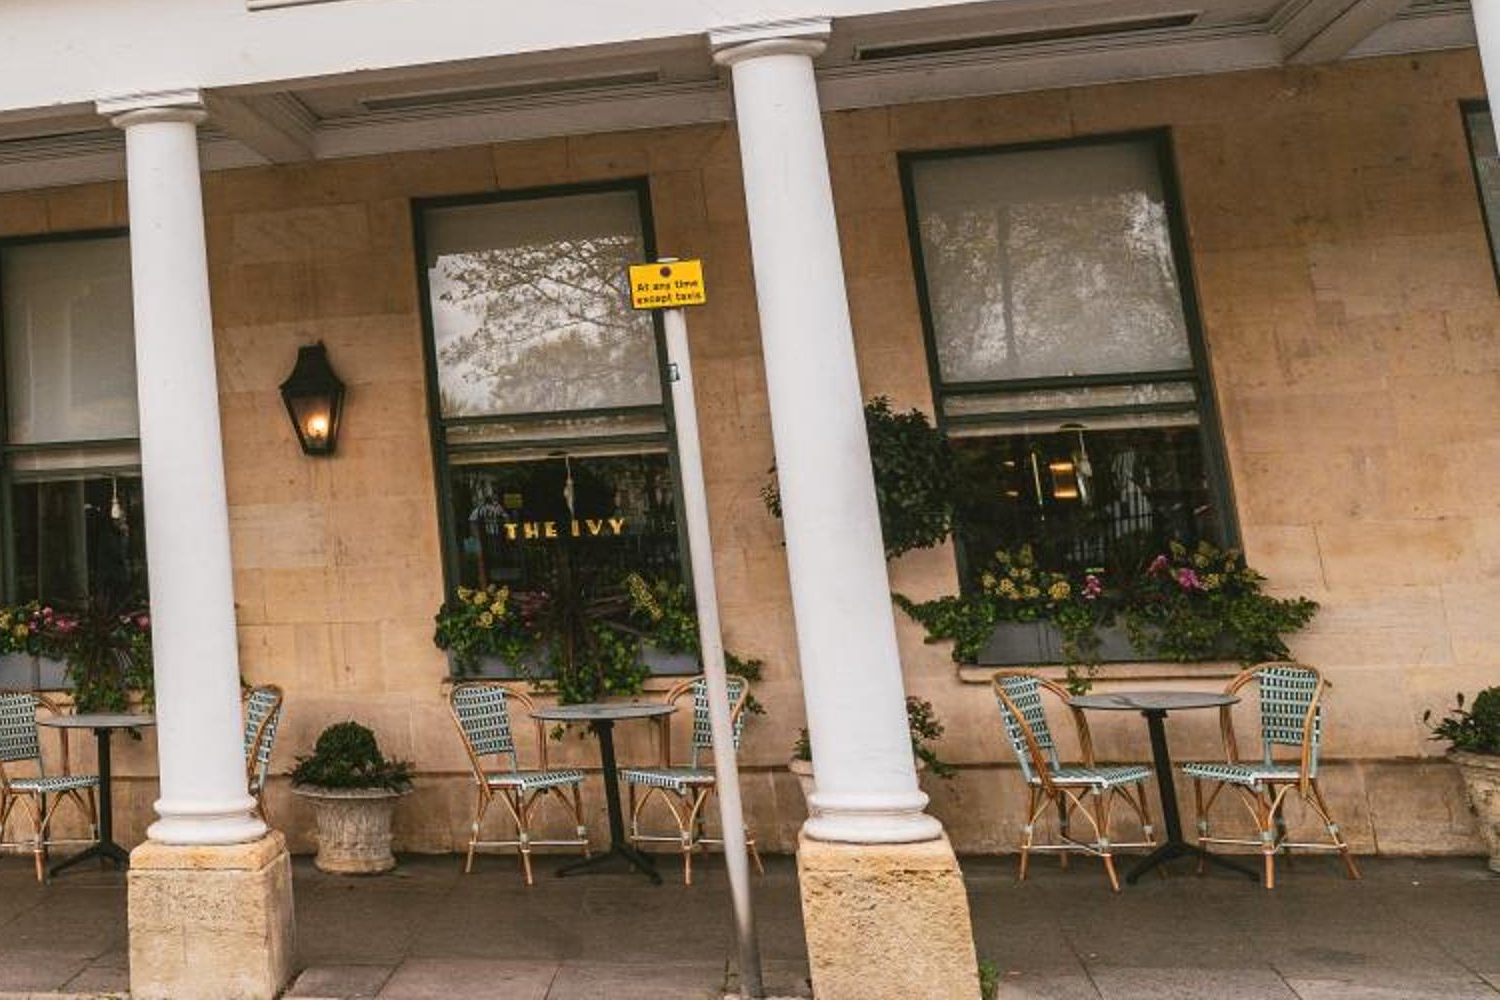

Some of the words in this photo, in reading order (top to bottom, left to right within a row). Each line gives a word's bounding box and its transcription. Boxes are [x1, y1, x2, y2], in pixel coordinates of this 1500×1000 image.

[637, 283, 649, 292] At
[675, 280, 698, 289] time
[637, 293, 672, 304] except
[503, 520, 558, 540] THE
[571, 517, 626, 538] IVY
